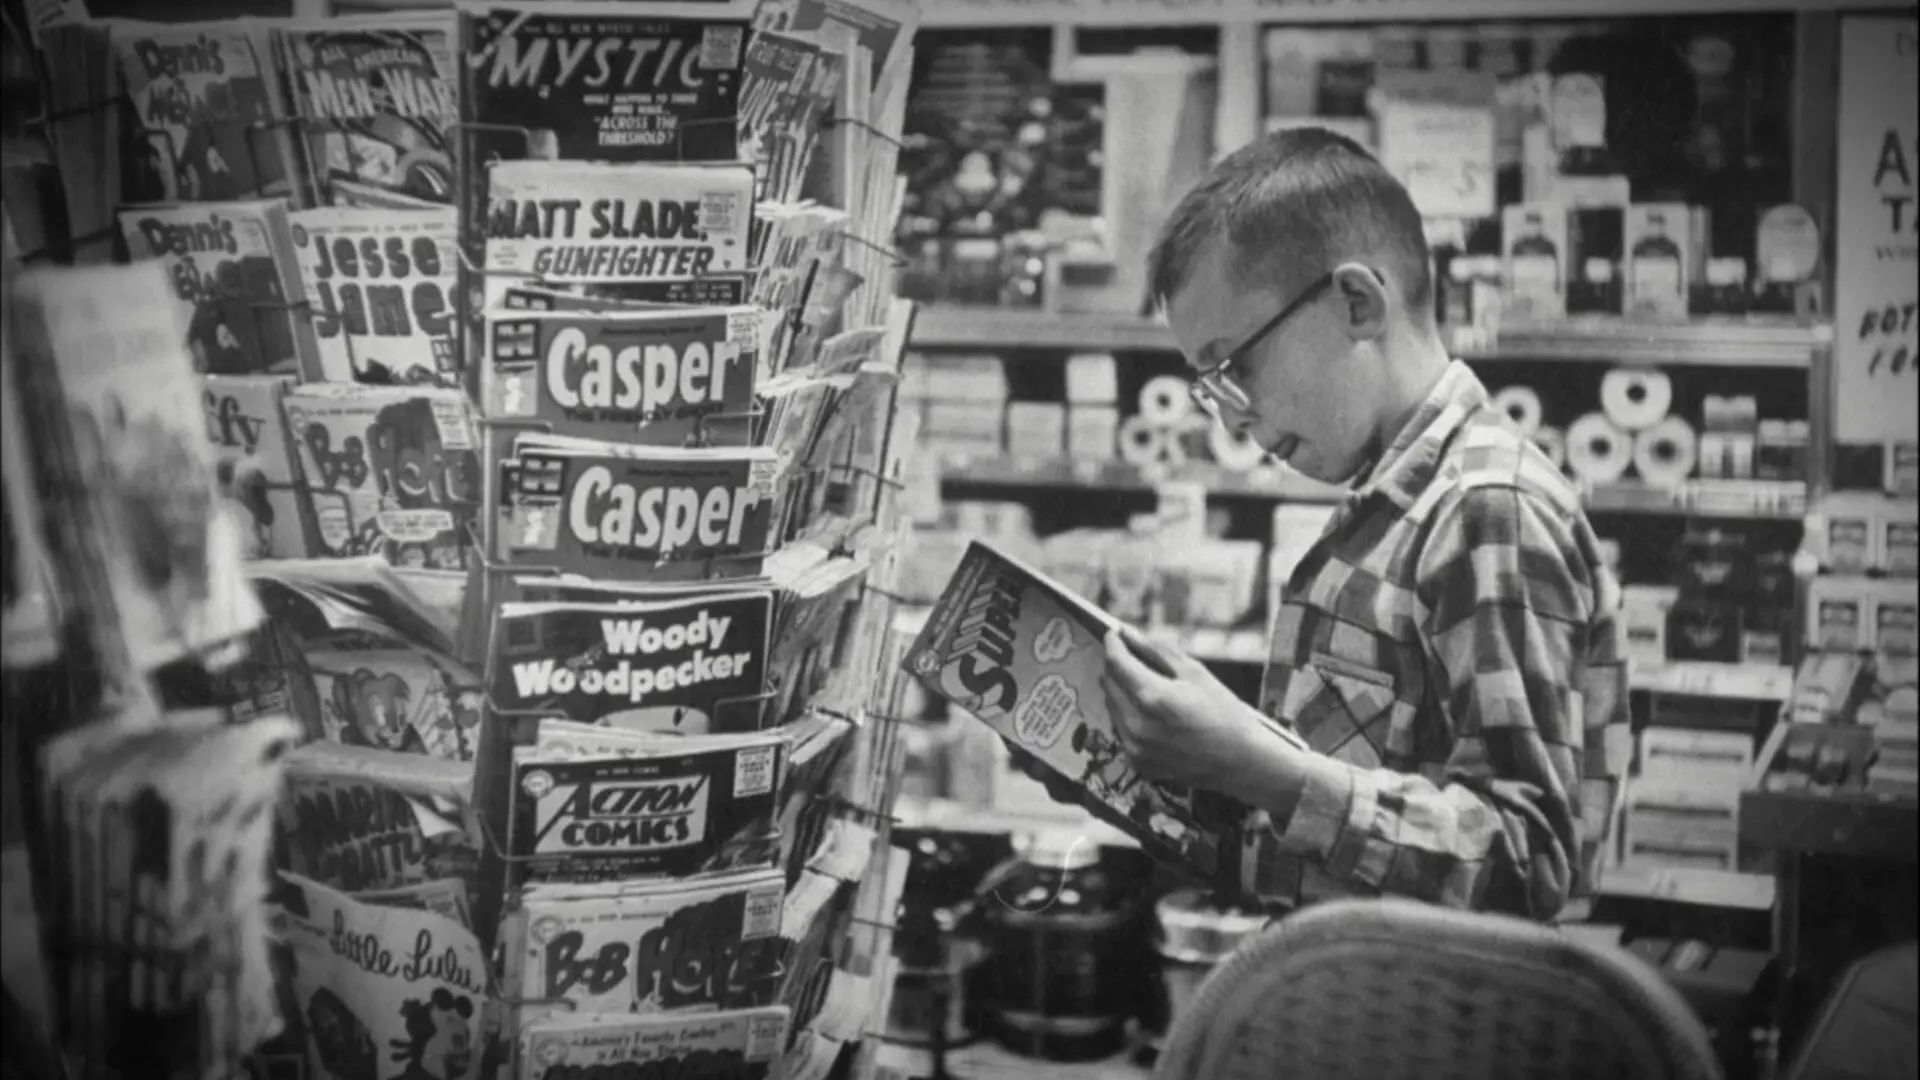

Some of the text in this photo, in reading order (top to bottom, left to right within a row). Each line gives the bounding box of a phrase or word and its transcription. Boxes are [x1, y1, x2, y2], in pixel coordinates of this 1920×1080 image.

[133, 32, 225, 79] Dennis
[488, 38, 704, 88] MYSTIC
[137, 212, 238, 256] Dennis
[488, 197, 583, 239] MATT
[532, 245, 715, 277] GUNFIGHTER
[546, 326, 741, 413] Casper
[568, 464, 760, 554] Casper
[601, 611, 732, 655] Woody
[512, 649, 752, 703] Woodpecker
[537, 774, 709, 836] ACTION
[561, 816, 690, 848] COMICS
[402, 928, 481, 994] Lulu
